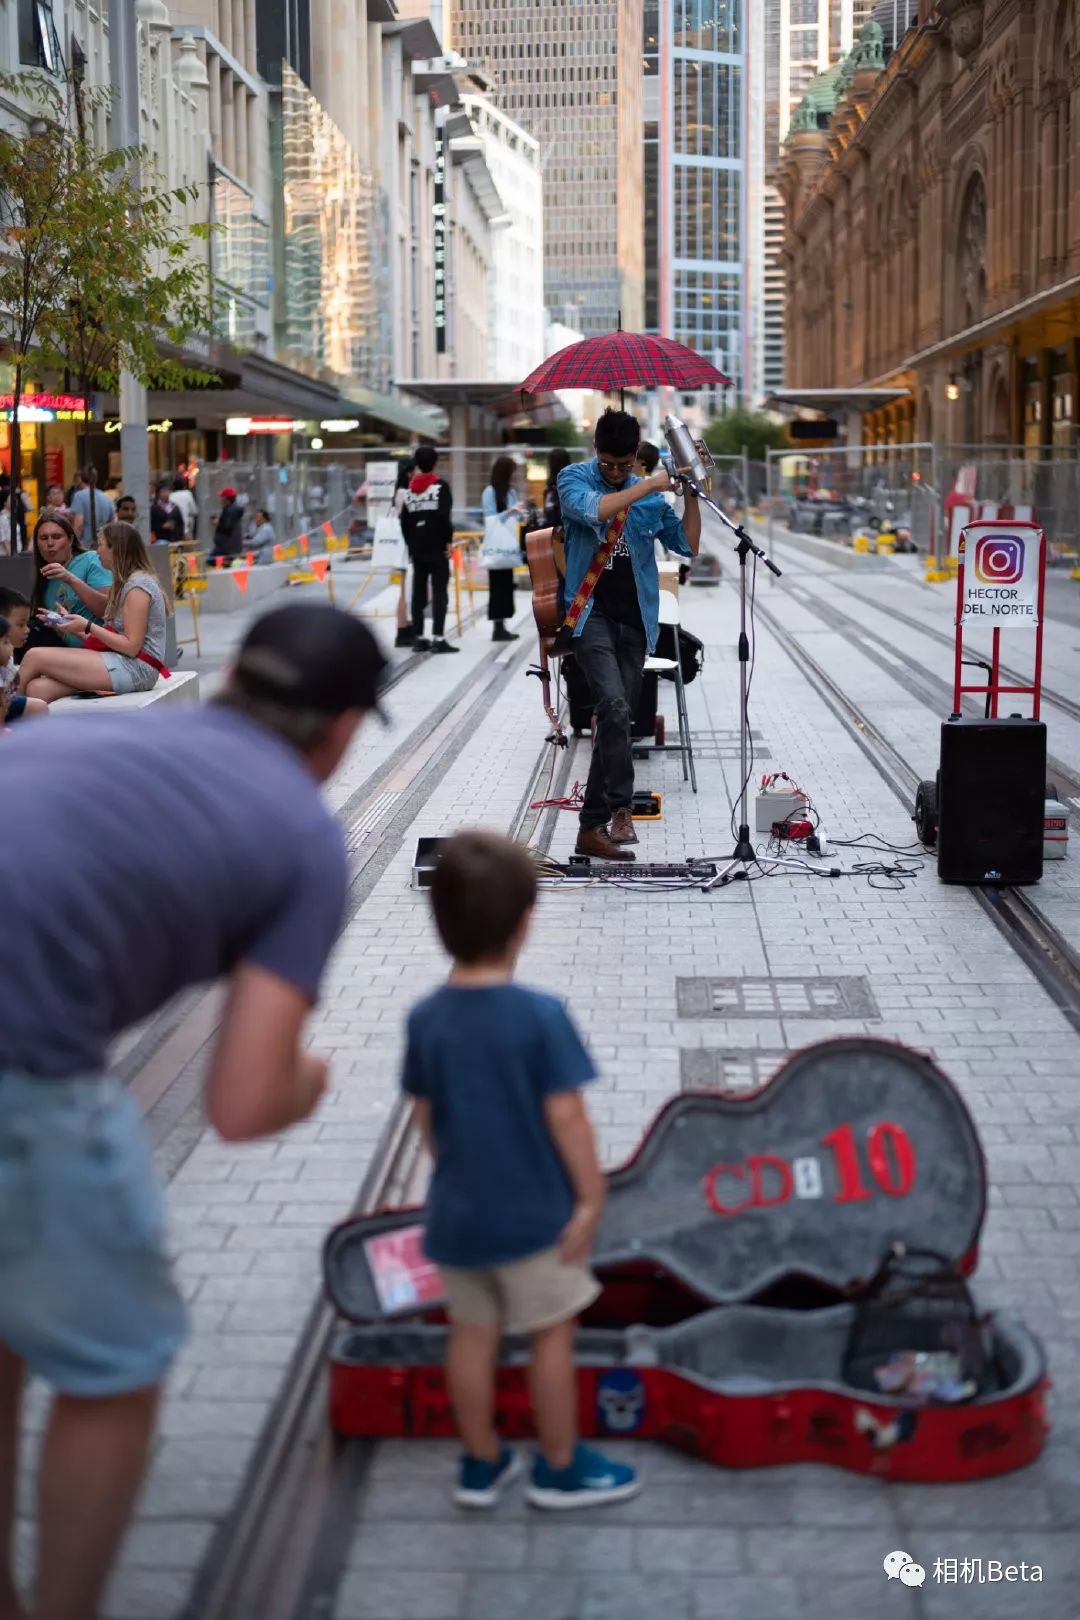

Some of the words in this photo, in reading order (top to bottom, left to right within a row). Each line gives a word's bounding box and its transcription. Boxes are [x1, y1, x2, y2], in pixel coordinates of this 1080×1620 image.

[963, 604, 1033, 615] DEL_NORTE
[704, 1153, 794, 1218] CD
[819, 1120, 917, 1205] 10
